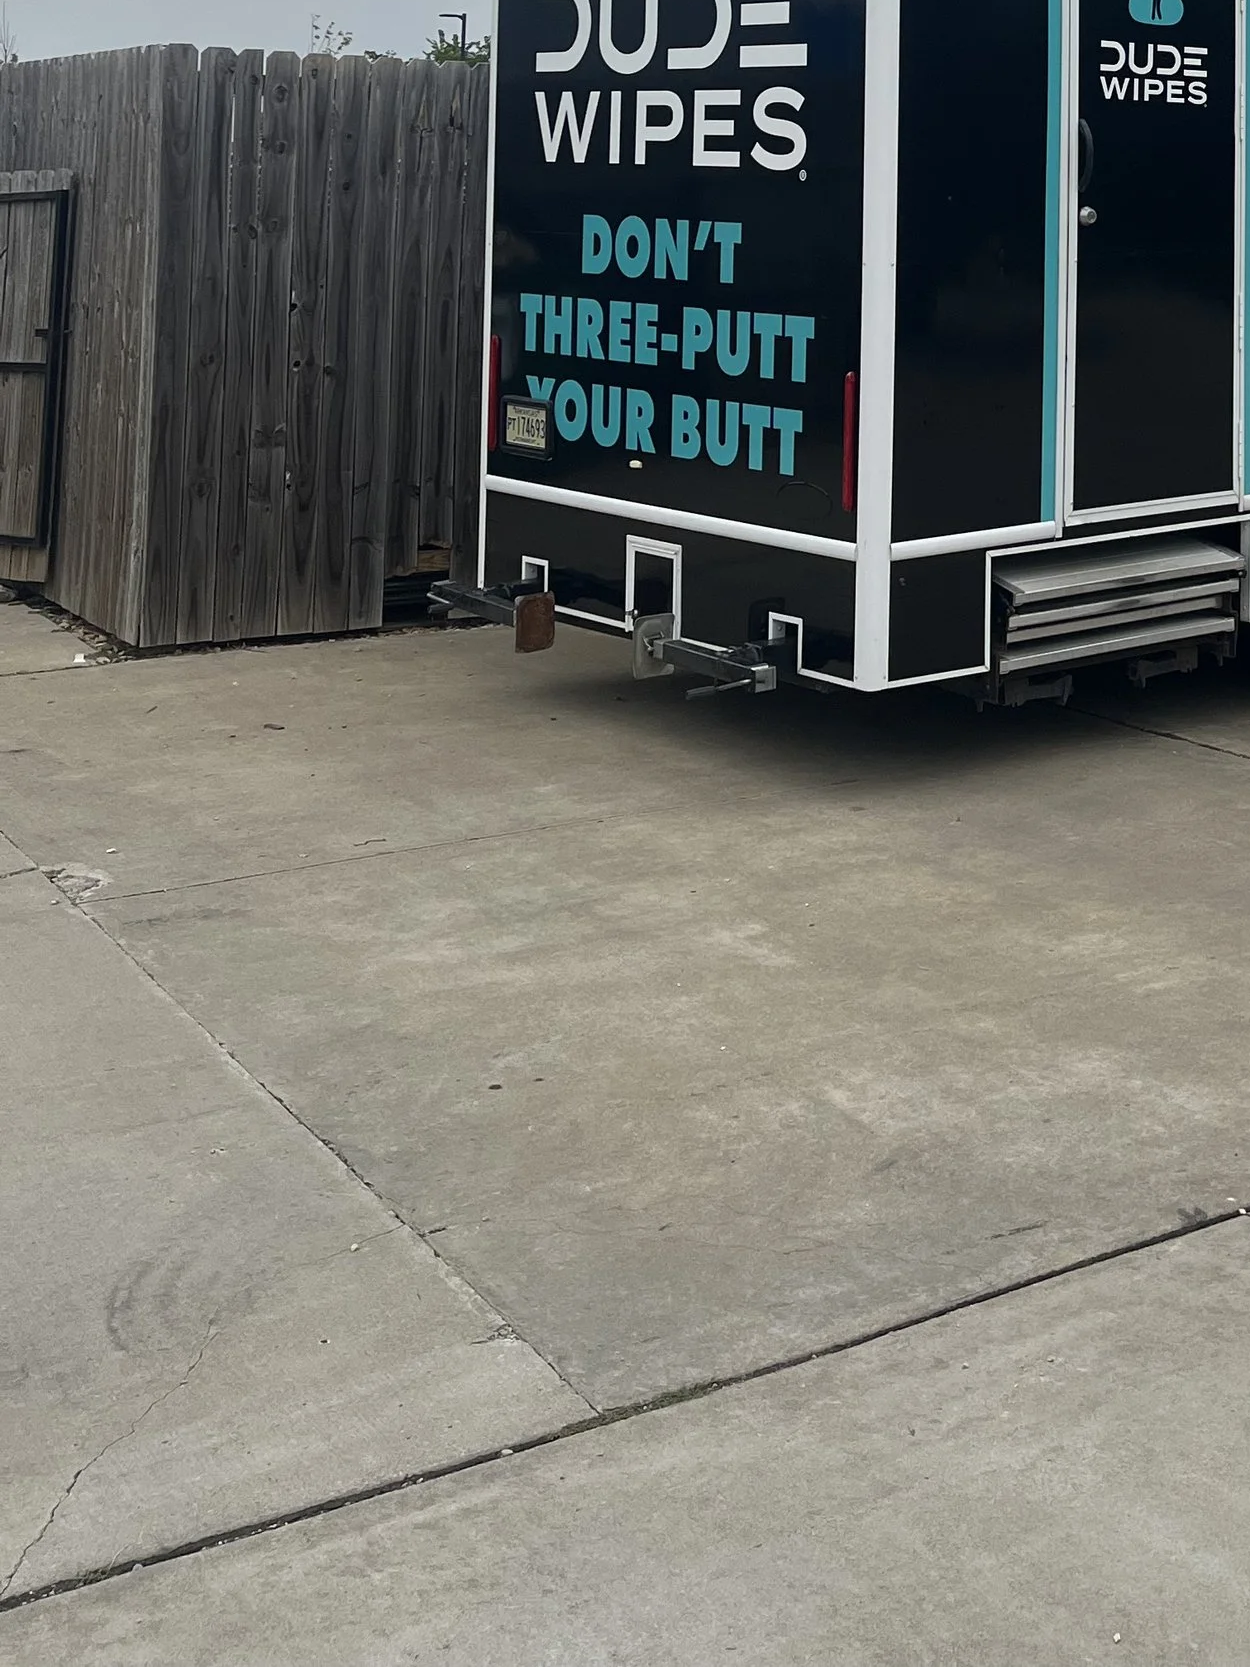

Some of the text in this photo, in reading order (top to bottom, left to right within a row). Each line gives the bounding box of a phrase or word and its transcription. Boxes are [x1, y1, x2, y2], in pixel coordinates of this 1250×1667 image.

[1100, 40, 1208, 77] DUDE
[1100, 77, 1208, 105] WIPES
[535, 87, 807, 171] WIPES
[582, 215, 742, 284] DON'T
[520, 293, 815, 383] THREE-PUTT
[671, 396, 803, 476] BUTT
